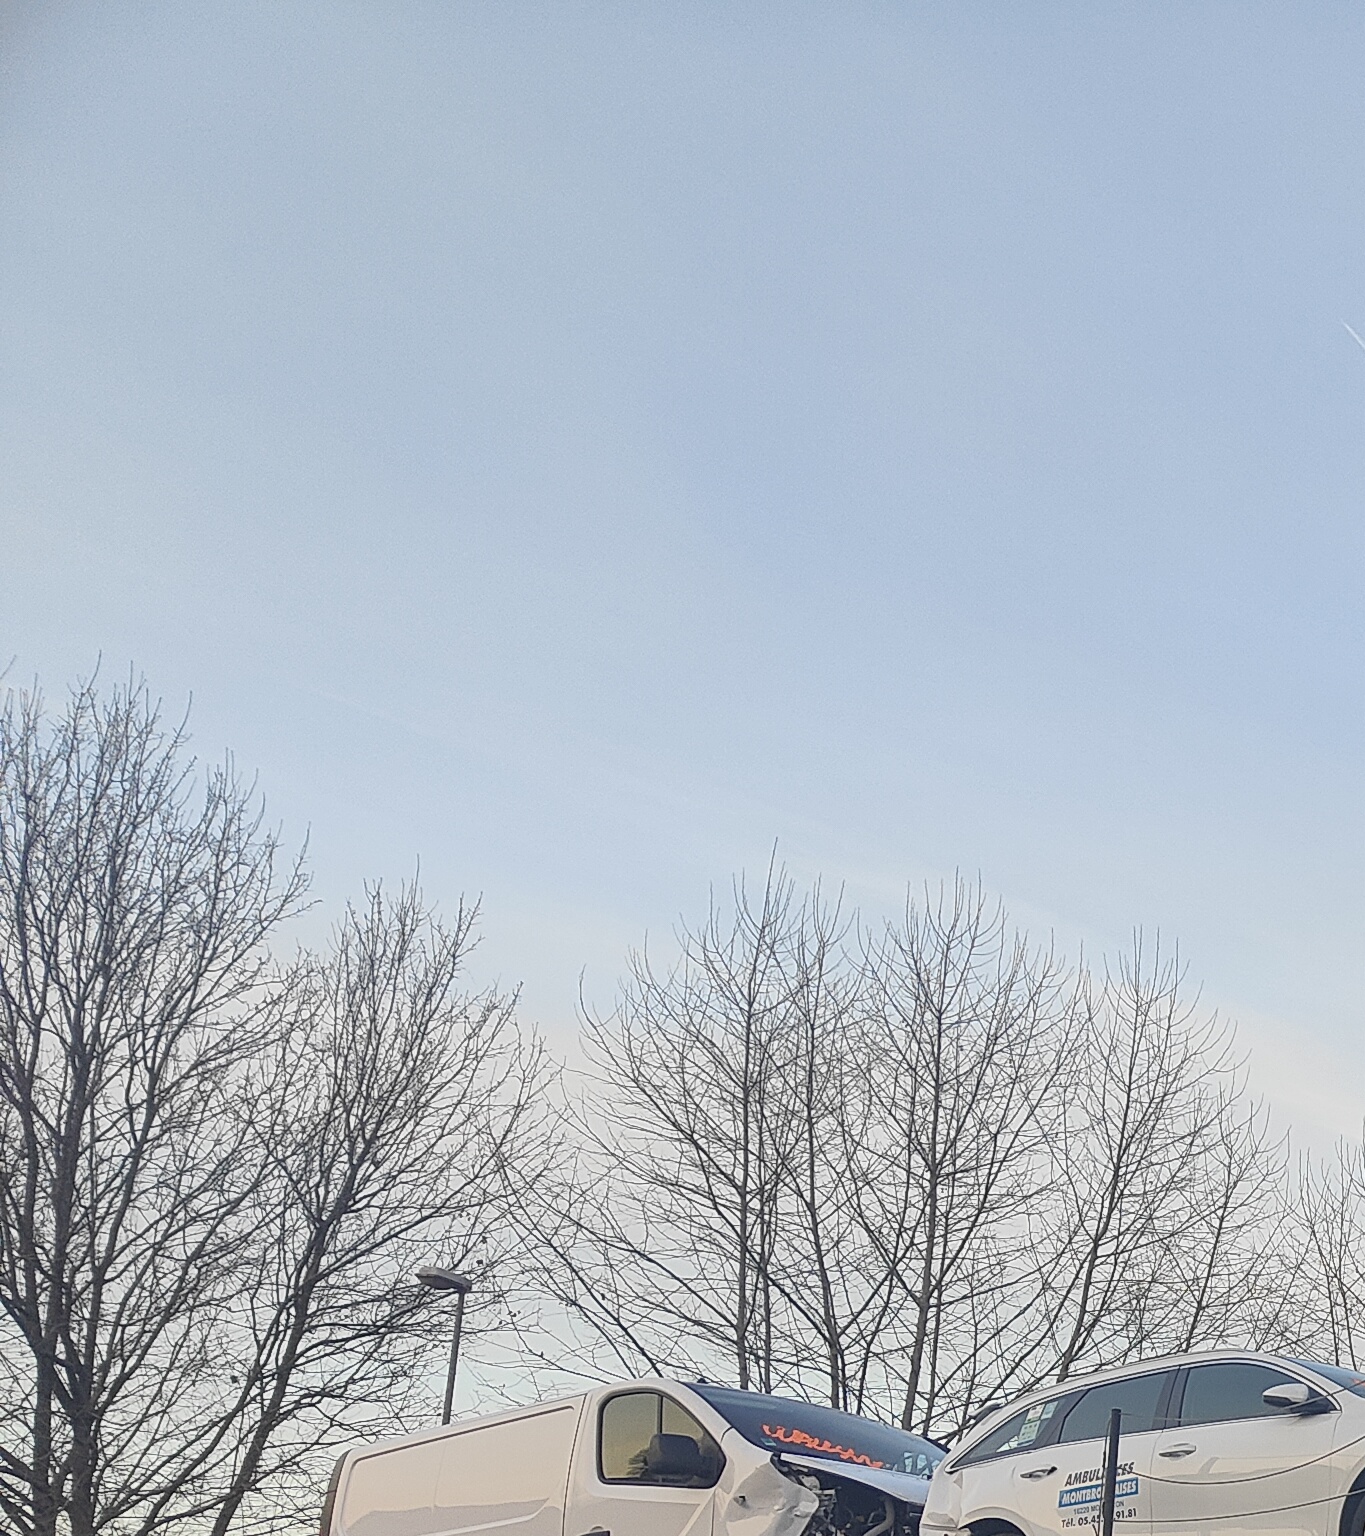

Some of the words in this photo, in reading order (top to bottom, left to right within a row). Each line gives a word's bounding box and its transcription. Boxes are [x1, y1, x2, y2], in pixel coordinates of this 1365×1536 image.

[1065, 1462, 1134, 1487] AMBULES
[1061, 1480, 1137, 1505] MONTBROAISES
[1078, 1508, 1137, 1526] 05.45..91.81
